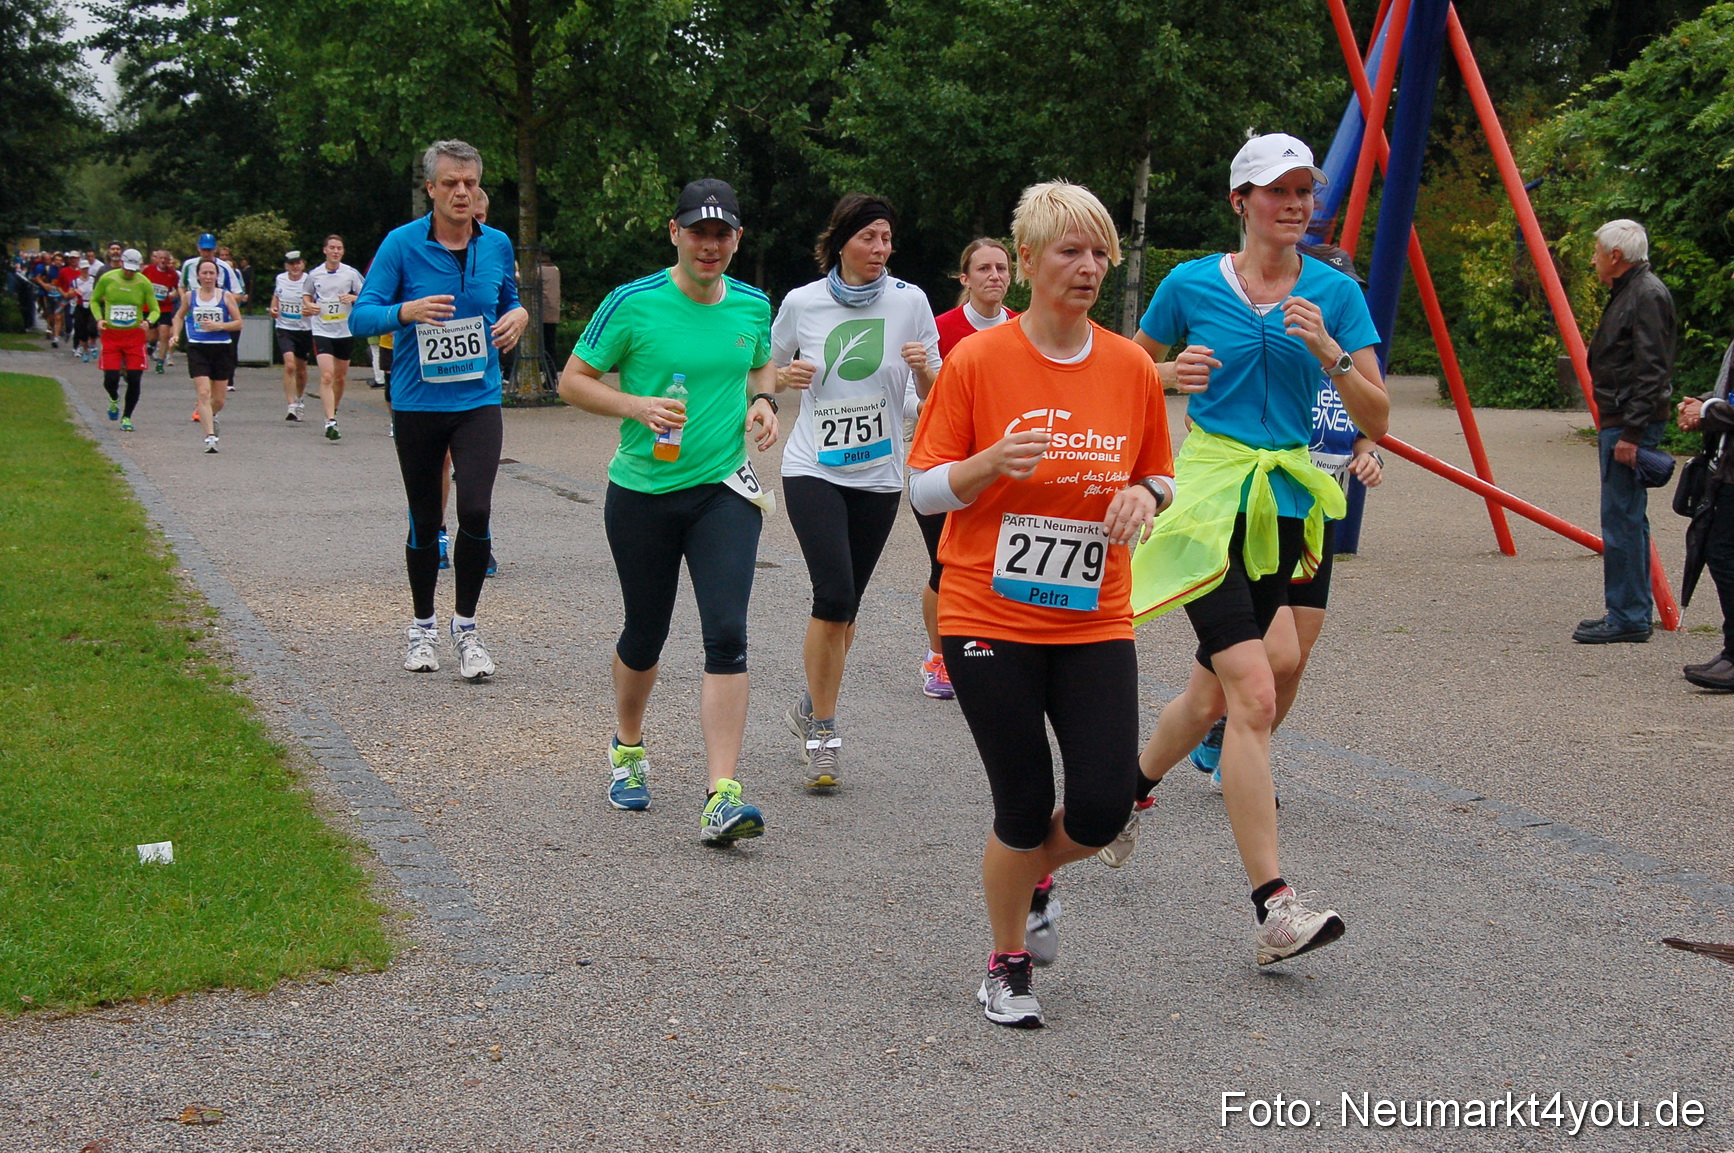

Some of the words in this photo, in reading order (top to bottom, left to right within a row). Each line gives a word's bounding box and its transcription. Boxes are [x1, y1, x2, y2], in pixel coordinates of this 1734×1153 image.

[281, 303, 300, 314] 2713
[328, 304, 340, 314] 27
[418, 328, 441, 336] PARTL
[442, 324, 473, 334] Neumarkt
[425, 332, 481, 361] 2356
[437, 362, 474, 375] Berthold
[813, 407, 840, 417] PARTL
[841, 403, 879, 414] Neumarkt
[821, 411, 883, 447] 2751
[1030, 427, 1127, 451] scher
[843, 450, 870, 463] Petra
[1042, 451, 1121, 462] AUTOMOBILE
[1056, 472, 1080, 484] und
[1082, 469, 1104, 482] das
[1002, 514, 1041, 529] PARTL
[1043, 519, 1100, 536] Neumarkt
[1005, 532, 1104, 582] 2779
[996, 568, 1002, 576] C
[1028, 587, 1069, 607] Petra
